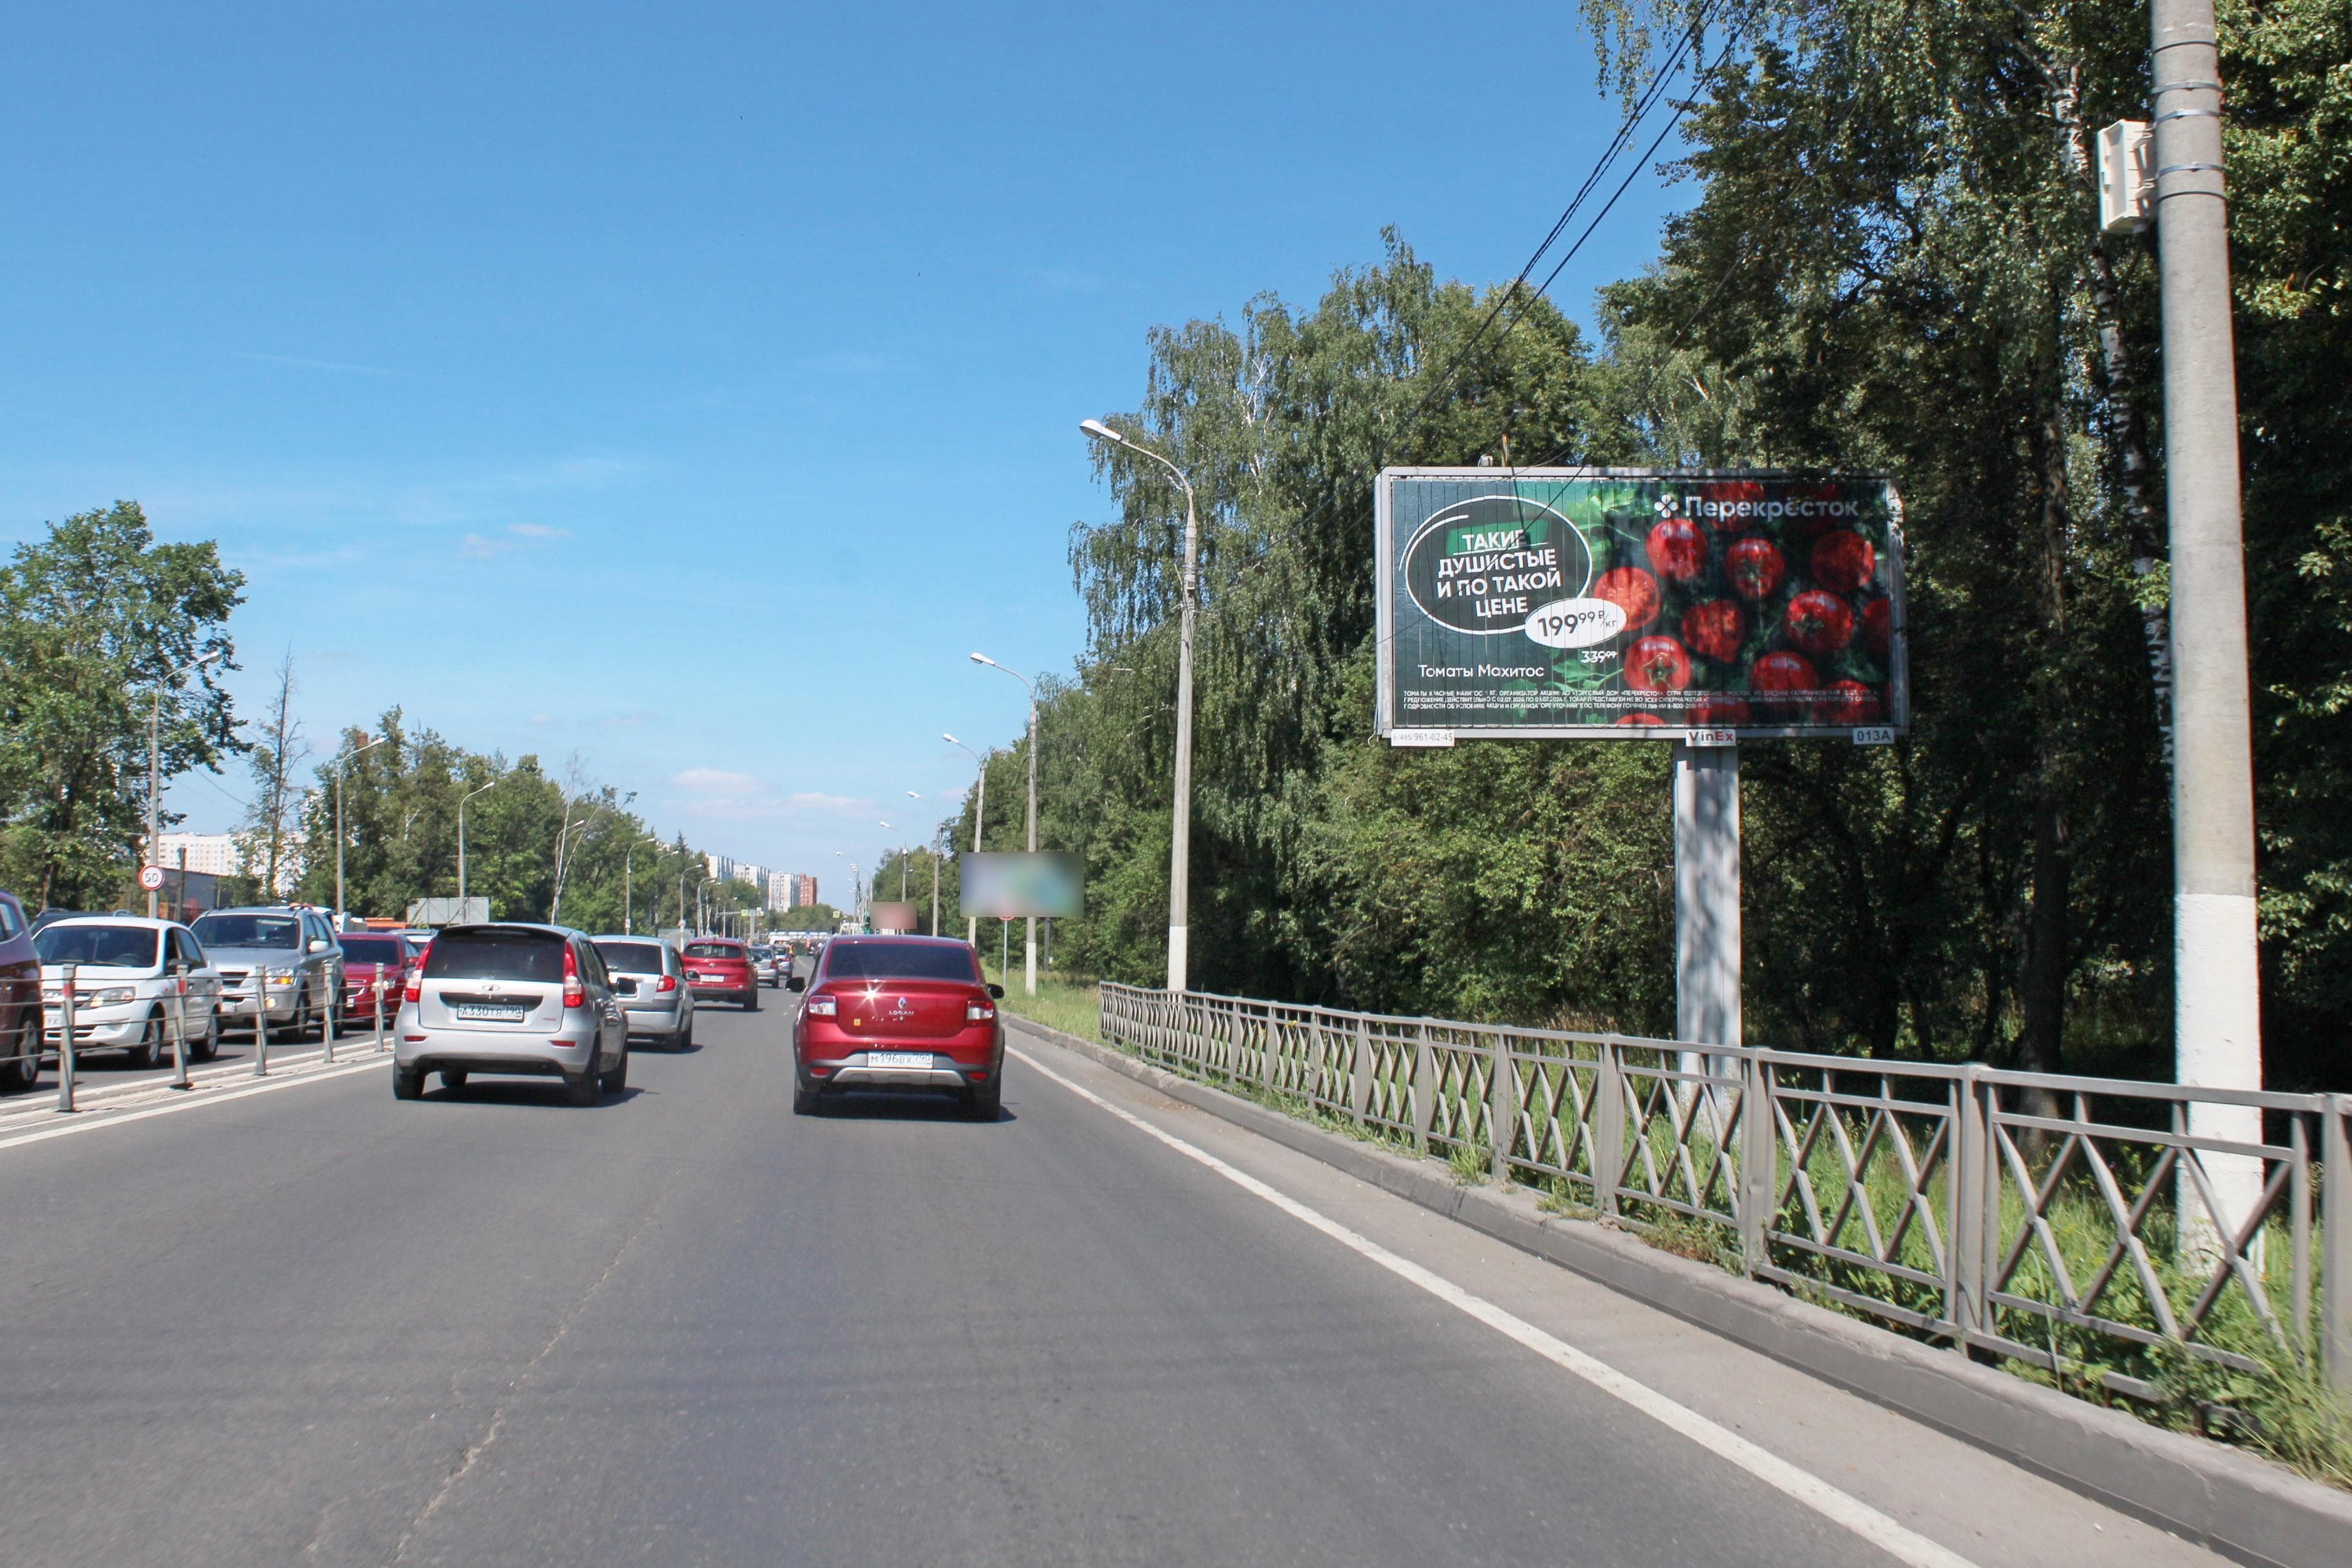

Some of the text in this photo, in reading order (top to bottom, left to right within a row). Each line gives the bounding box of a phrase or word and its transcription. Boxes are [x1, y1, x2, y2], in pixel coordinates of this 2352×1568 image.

[1685, 496, 1860, 522] Перекрёсток
[1438, 549, 1557, 579] ДУШИСТЫЕ
[1436, 567, 1562, 599] И ПО ТАКОЙ
[1475, 596, 1529, 619] ЦЕНЕ
[1418, 663, 1545, 678] Томаты Махитос
[1688, 731, 1733, 741] VinEx
[145, 872, 159, 883] 50
